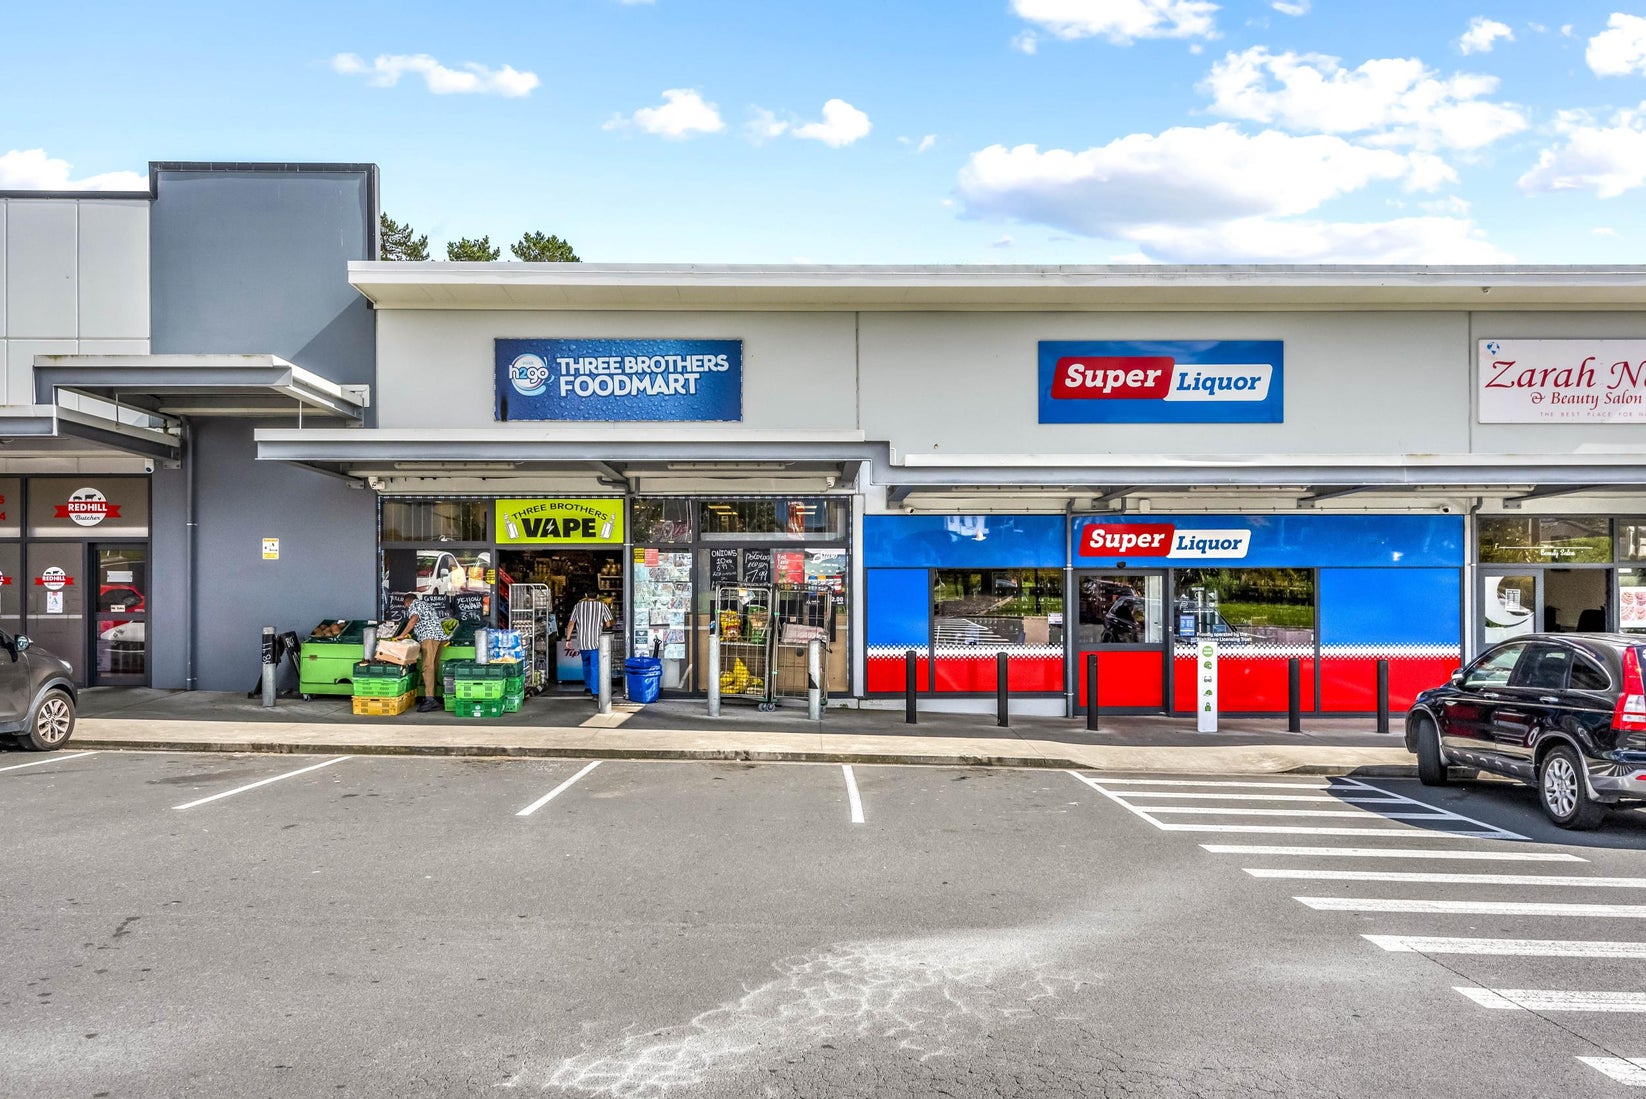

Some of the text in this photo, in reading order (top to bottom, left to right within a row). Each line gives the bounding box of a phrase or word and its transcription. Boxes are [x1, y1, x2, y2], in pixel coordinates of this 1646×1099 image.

[508, 364, 549, 385] h2go
[557, 354, 729, 375] THREE BROTHERS
[1484, 356, 1646, 390] Zarah N
[560, 373, 700, 397] FOODMART
[1064, 363, 1262, 396] Super Liquor
[1550, 391, 1599, 410] Beauty
[1604, 389, 1642, 405] Salon
[68, 503, 108, 512] REDHILL
[511, 502, 608, 520] THREE BROTHERS
[521, 518, 597, 538] VAPE
[1089, 528, 1243, 554] Super Liquor
[711, 549, 738, 558] ONIONS
